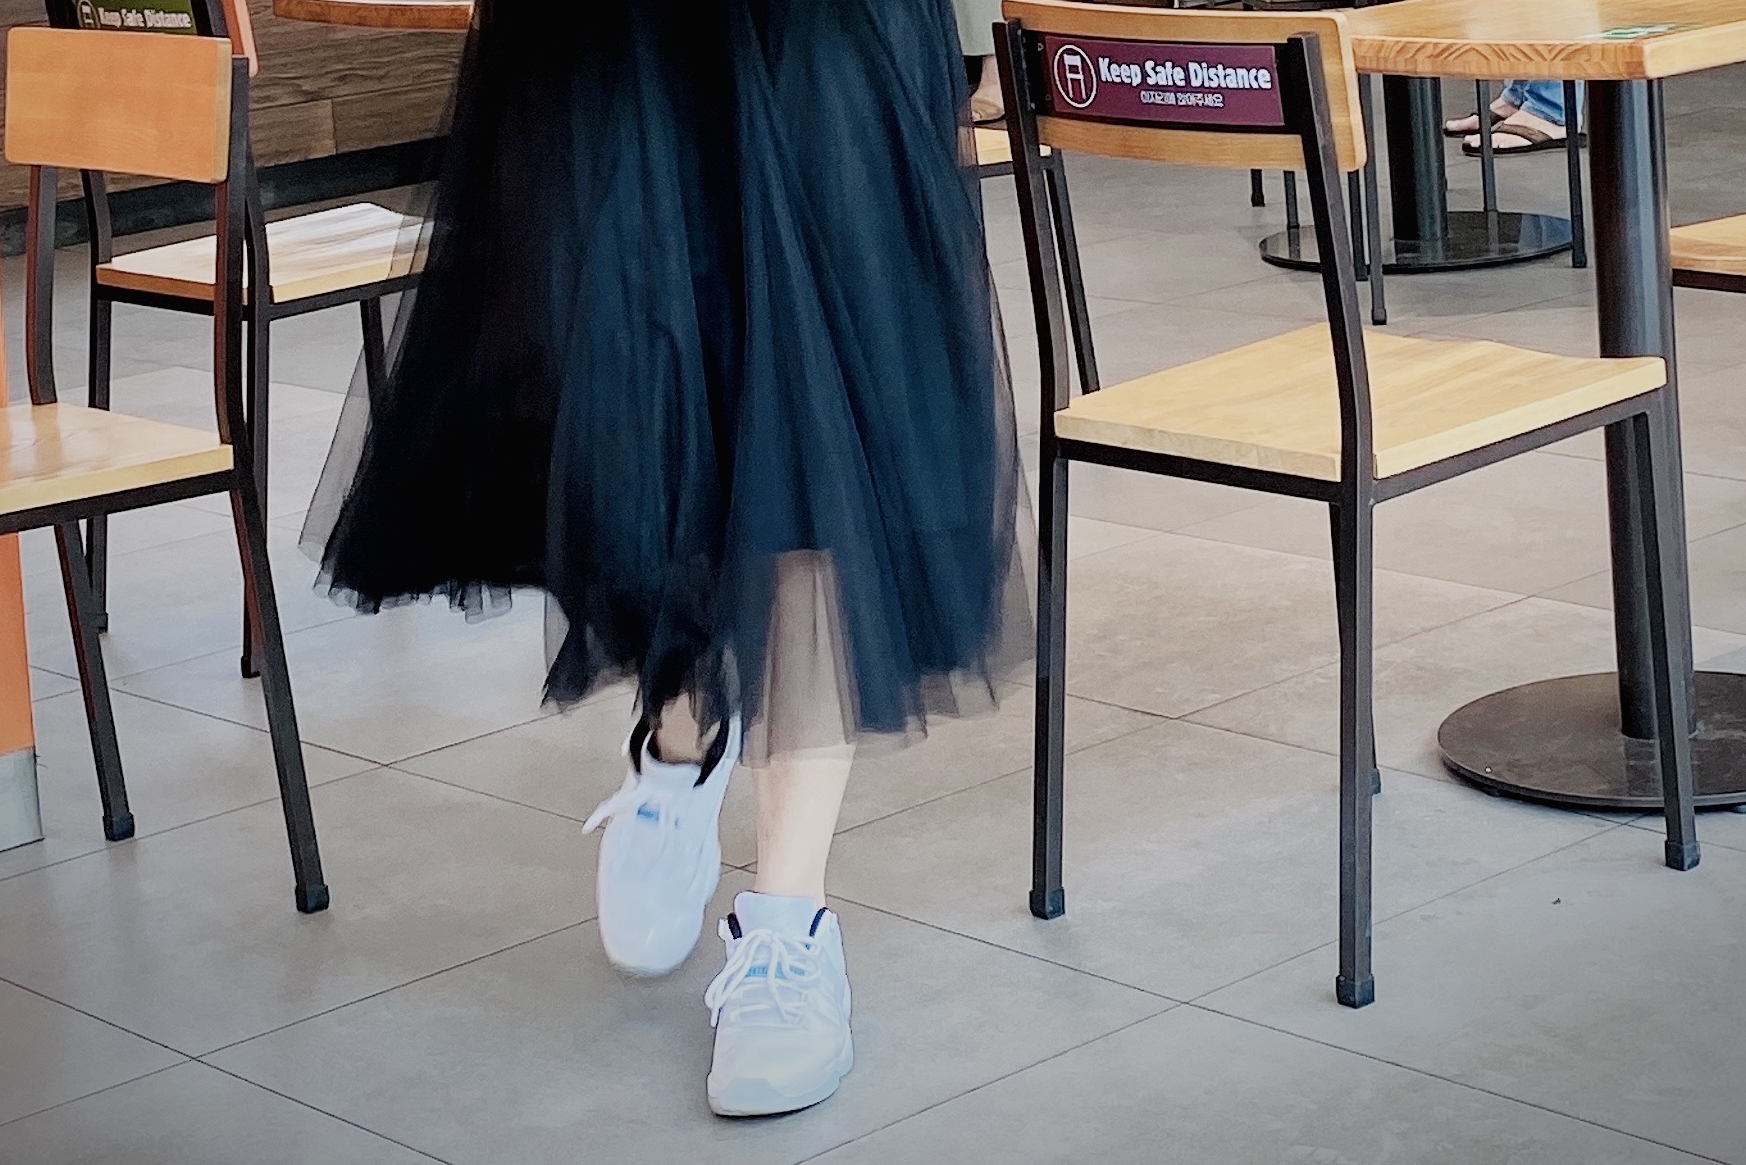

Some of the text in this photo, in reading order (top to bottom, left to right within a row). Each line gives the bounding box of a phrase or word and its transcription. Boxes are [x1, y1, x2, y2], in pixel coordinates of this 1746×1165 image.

[121, 8, 145, 28] Safe
[144, 9, 192, 28] Distance
[1098, 57, 1272, 89] Keep Safe Distance
